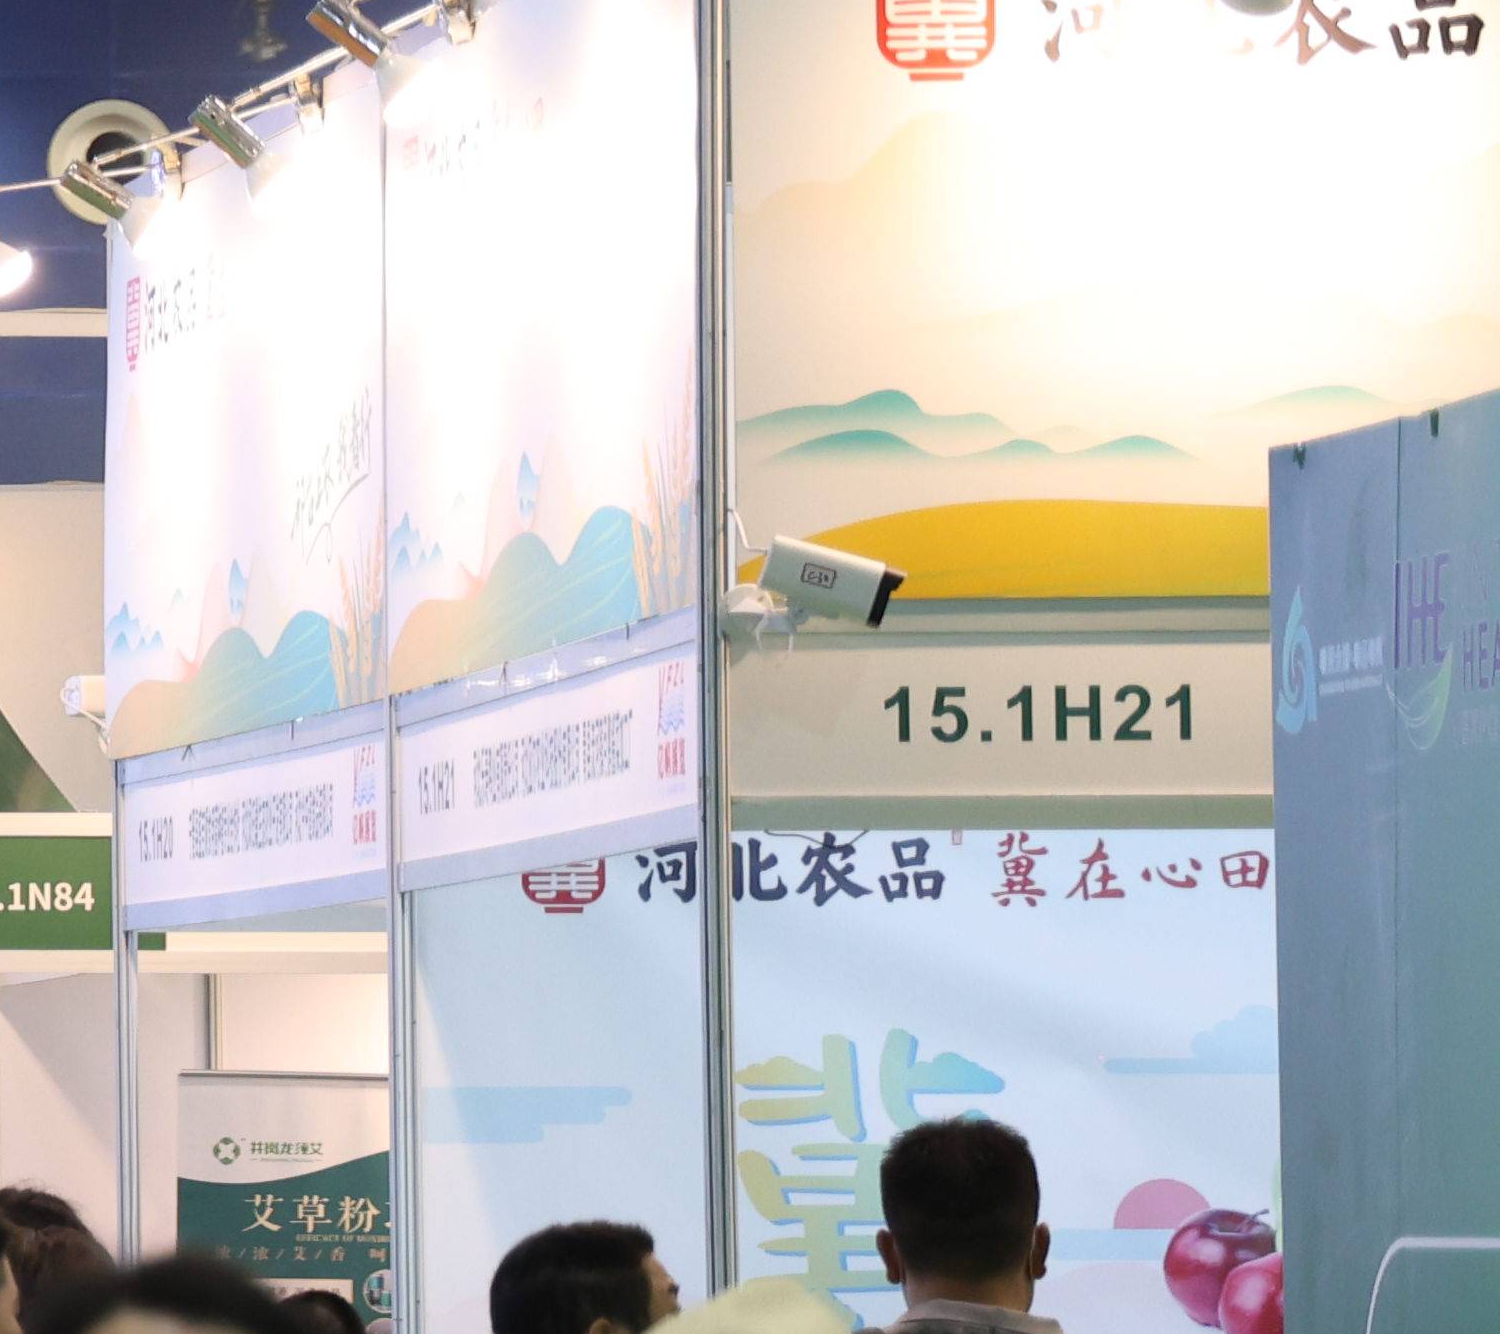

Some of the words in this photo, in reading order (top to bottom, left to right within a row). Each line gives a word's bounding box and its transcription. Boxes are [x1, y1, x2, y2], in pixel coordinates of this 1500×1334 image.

[883, 683, 1193, 743] 15.1H21
[241, 1194, 391, 1234] 艾草粉
